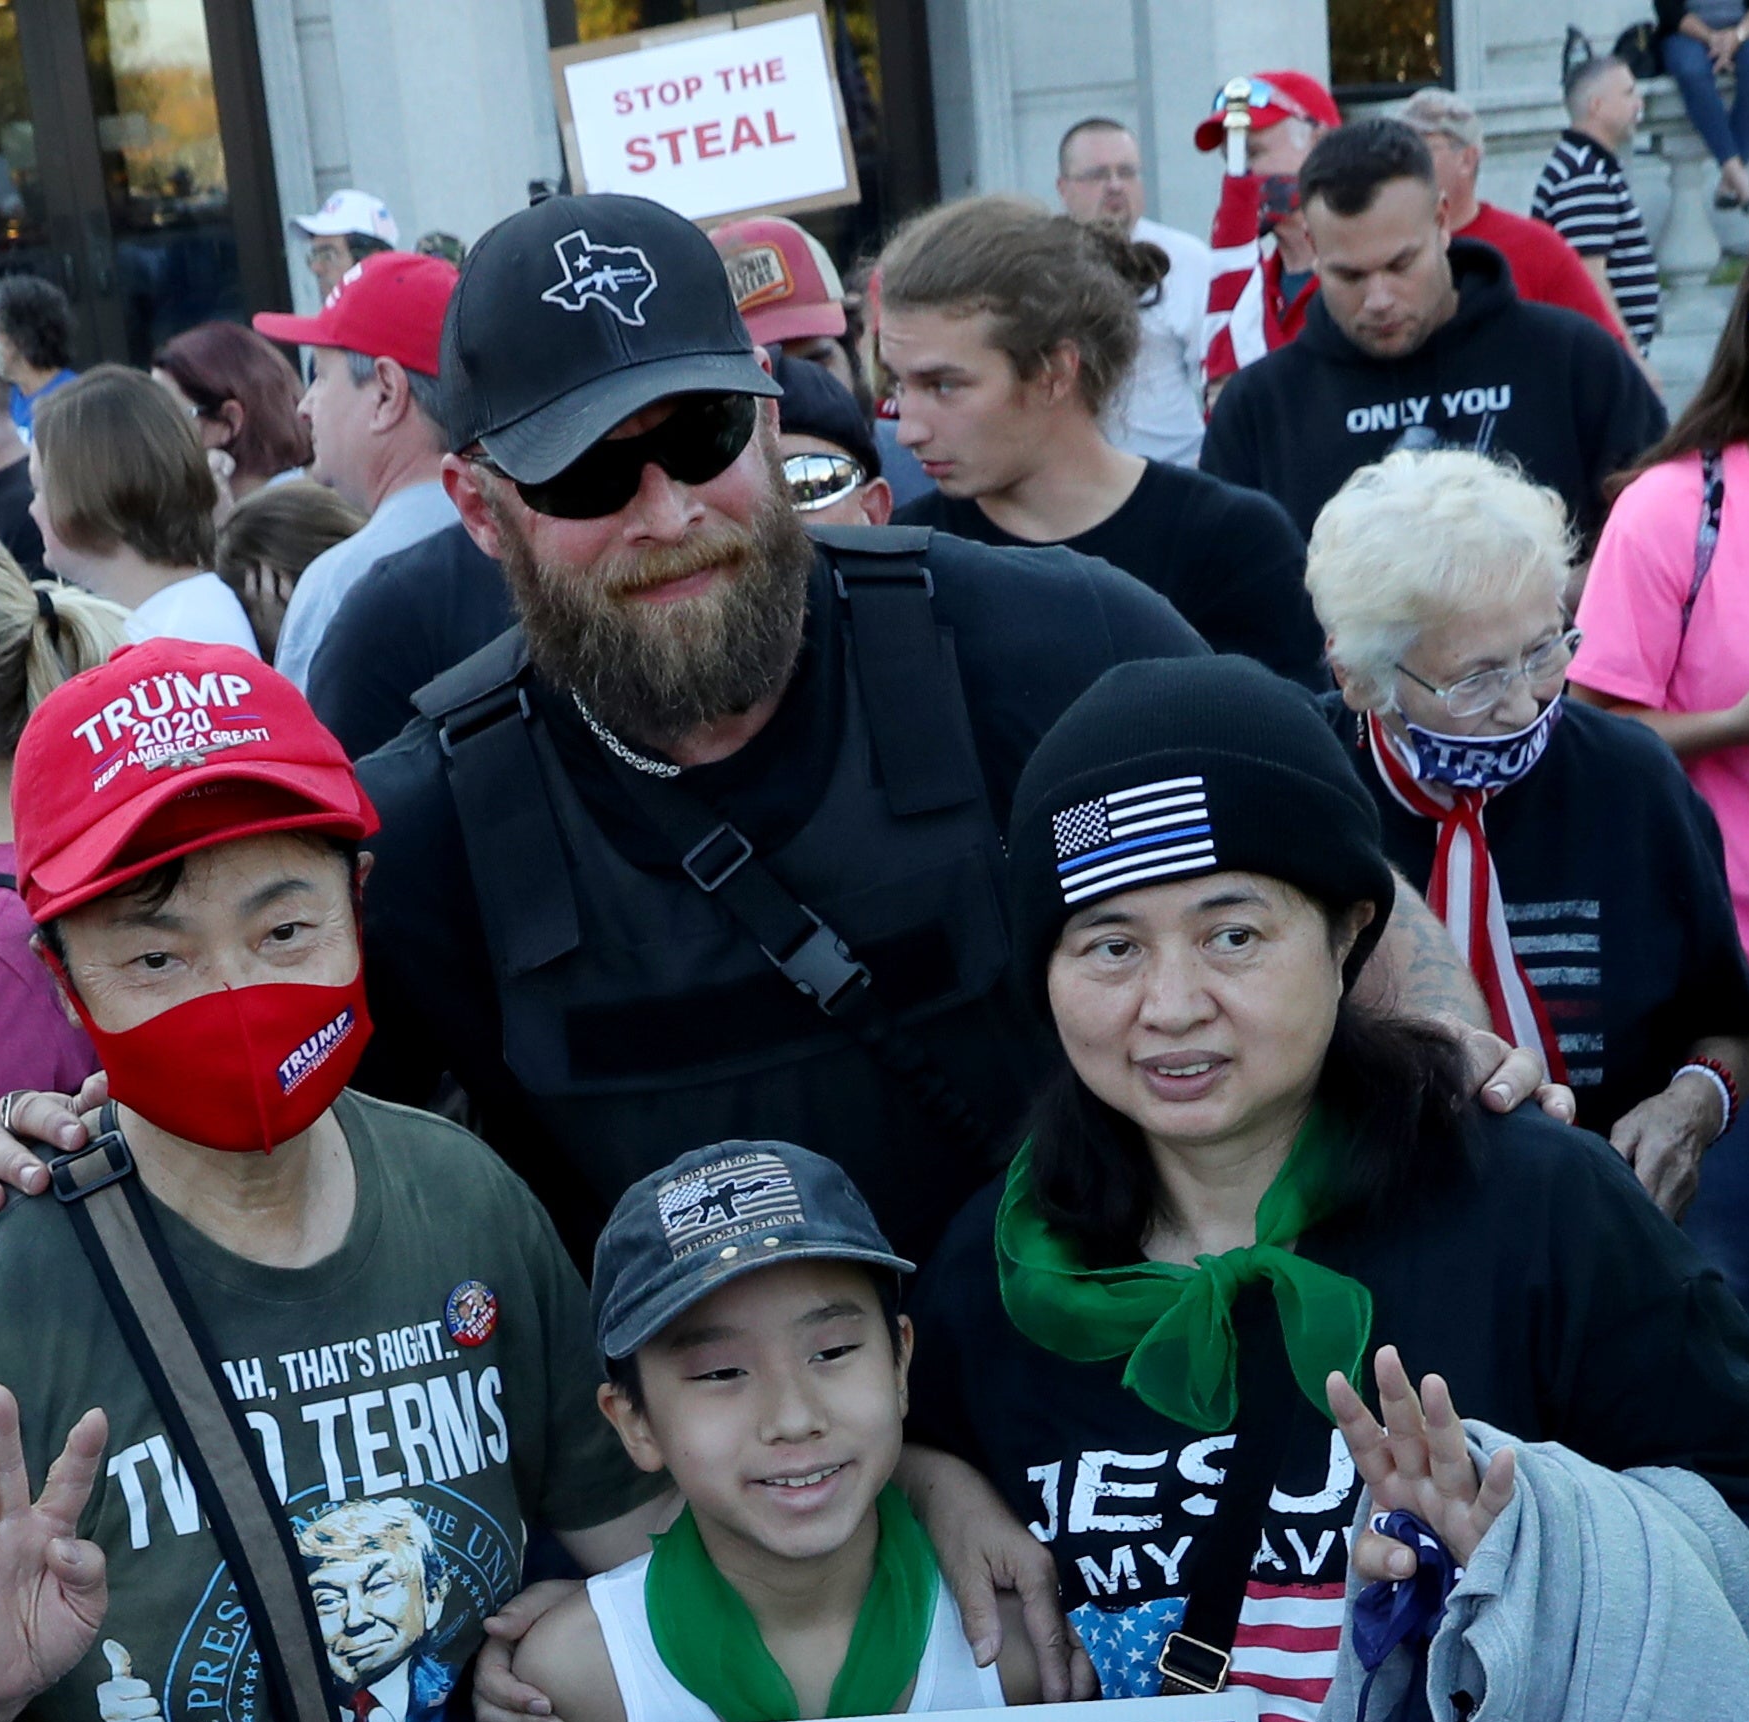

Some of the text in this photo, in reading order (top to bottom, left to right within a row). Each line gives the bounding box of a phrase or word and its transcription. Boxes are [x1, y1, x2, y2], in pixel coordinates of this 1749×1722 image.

[614, 58, 786, 115] STOP THE
[625, 109, 796, 173] STEAL
[1346, 385, 1511, 433] ONLY YOU
[72, 671, 253, 755] TRUMP
[132, 709, 213, 748] 2020
[93, 726, 271, 793] KEEP AMERICA GREAT!
[278, 1010, 349, 1080] TRUMP
[675, 1153, 759, 1185] ROD OF IRON
[673, 1213, 804, 1260] FREEDOM FESTIVAL
[466, 1306, 497, 1339] TRUMP
[279, 1333, 376, 1394] THAT'S
[301, 1366, 509, 1501] TERMS
[1075, 1536, 1193, 1596] MY
